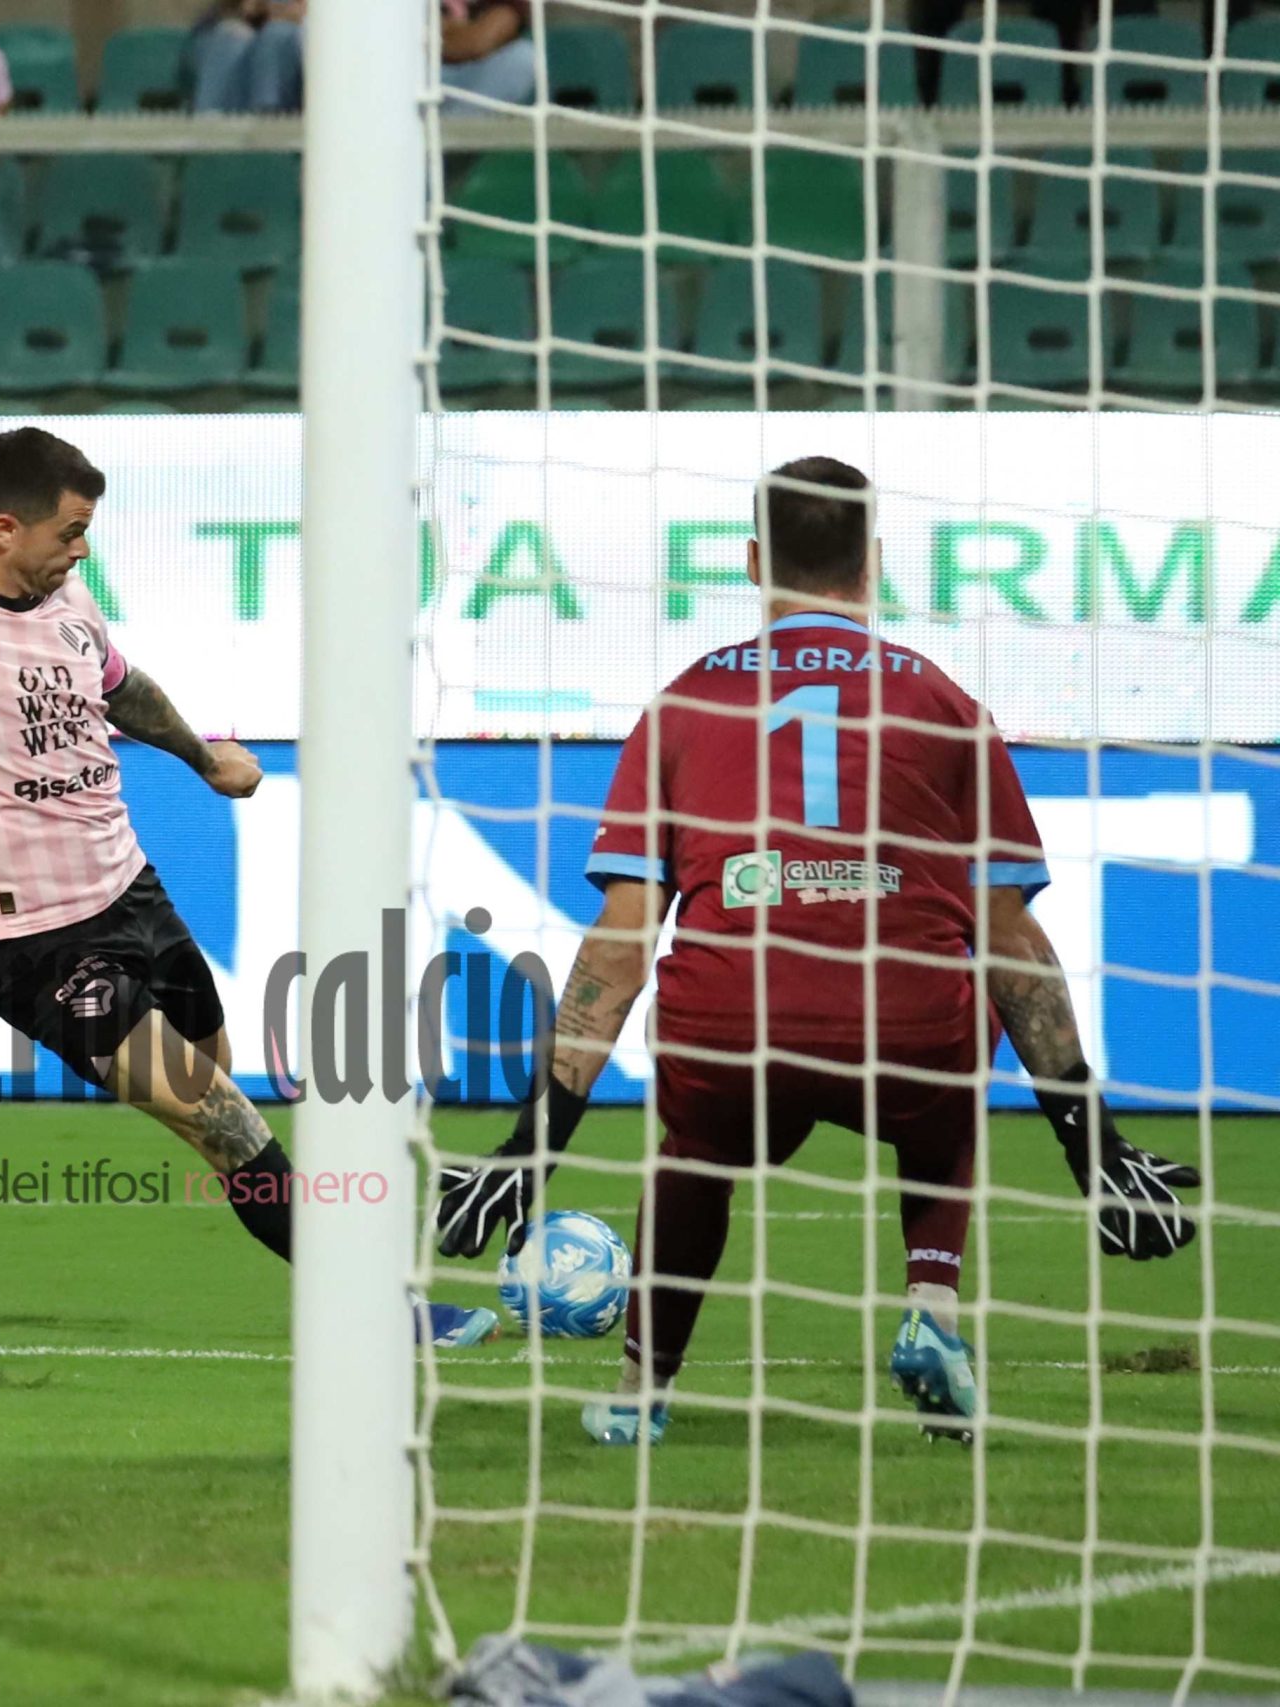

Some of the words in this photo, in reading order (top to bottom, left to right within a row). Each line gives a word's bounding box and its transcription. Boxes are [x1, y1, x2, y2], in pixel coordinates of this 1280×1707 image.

[193, 518, 583, 624] TA
[663, 518, 1280, 626] FRM
[704, 648, 922, 675] MELGRATI
[766, 684, 840, 828] 1
